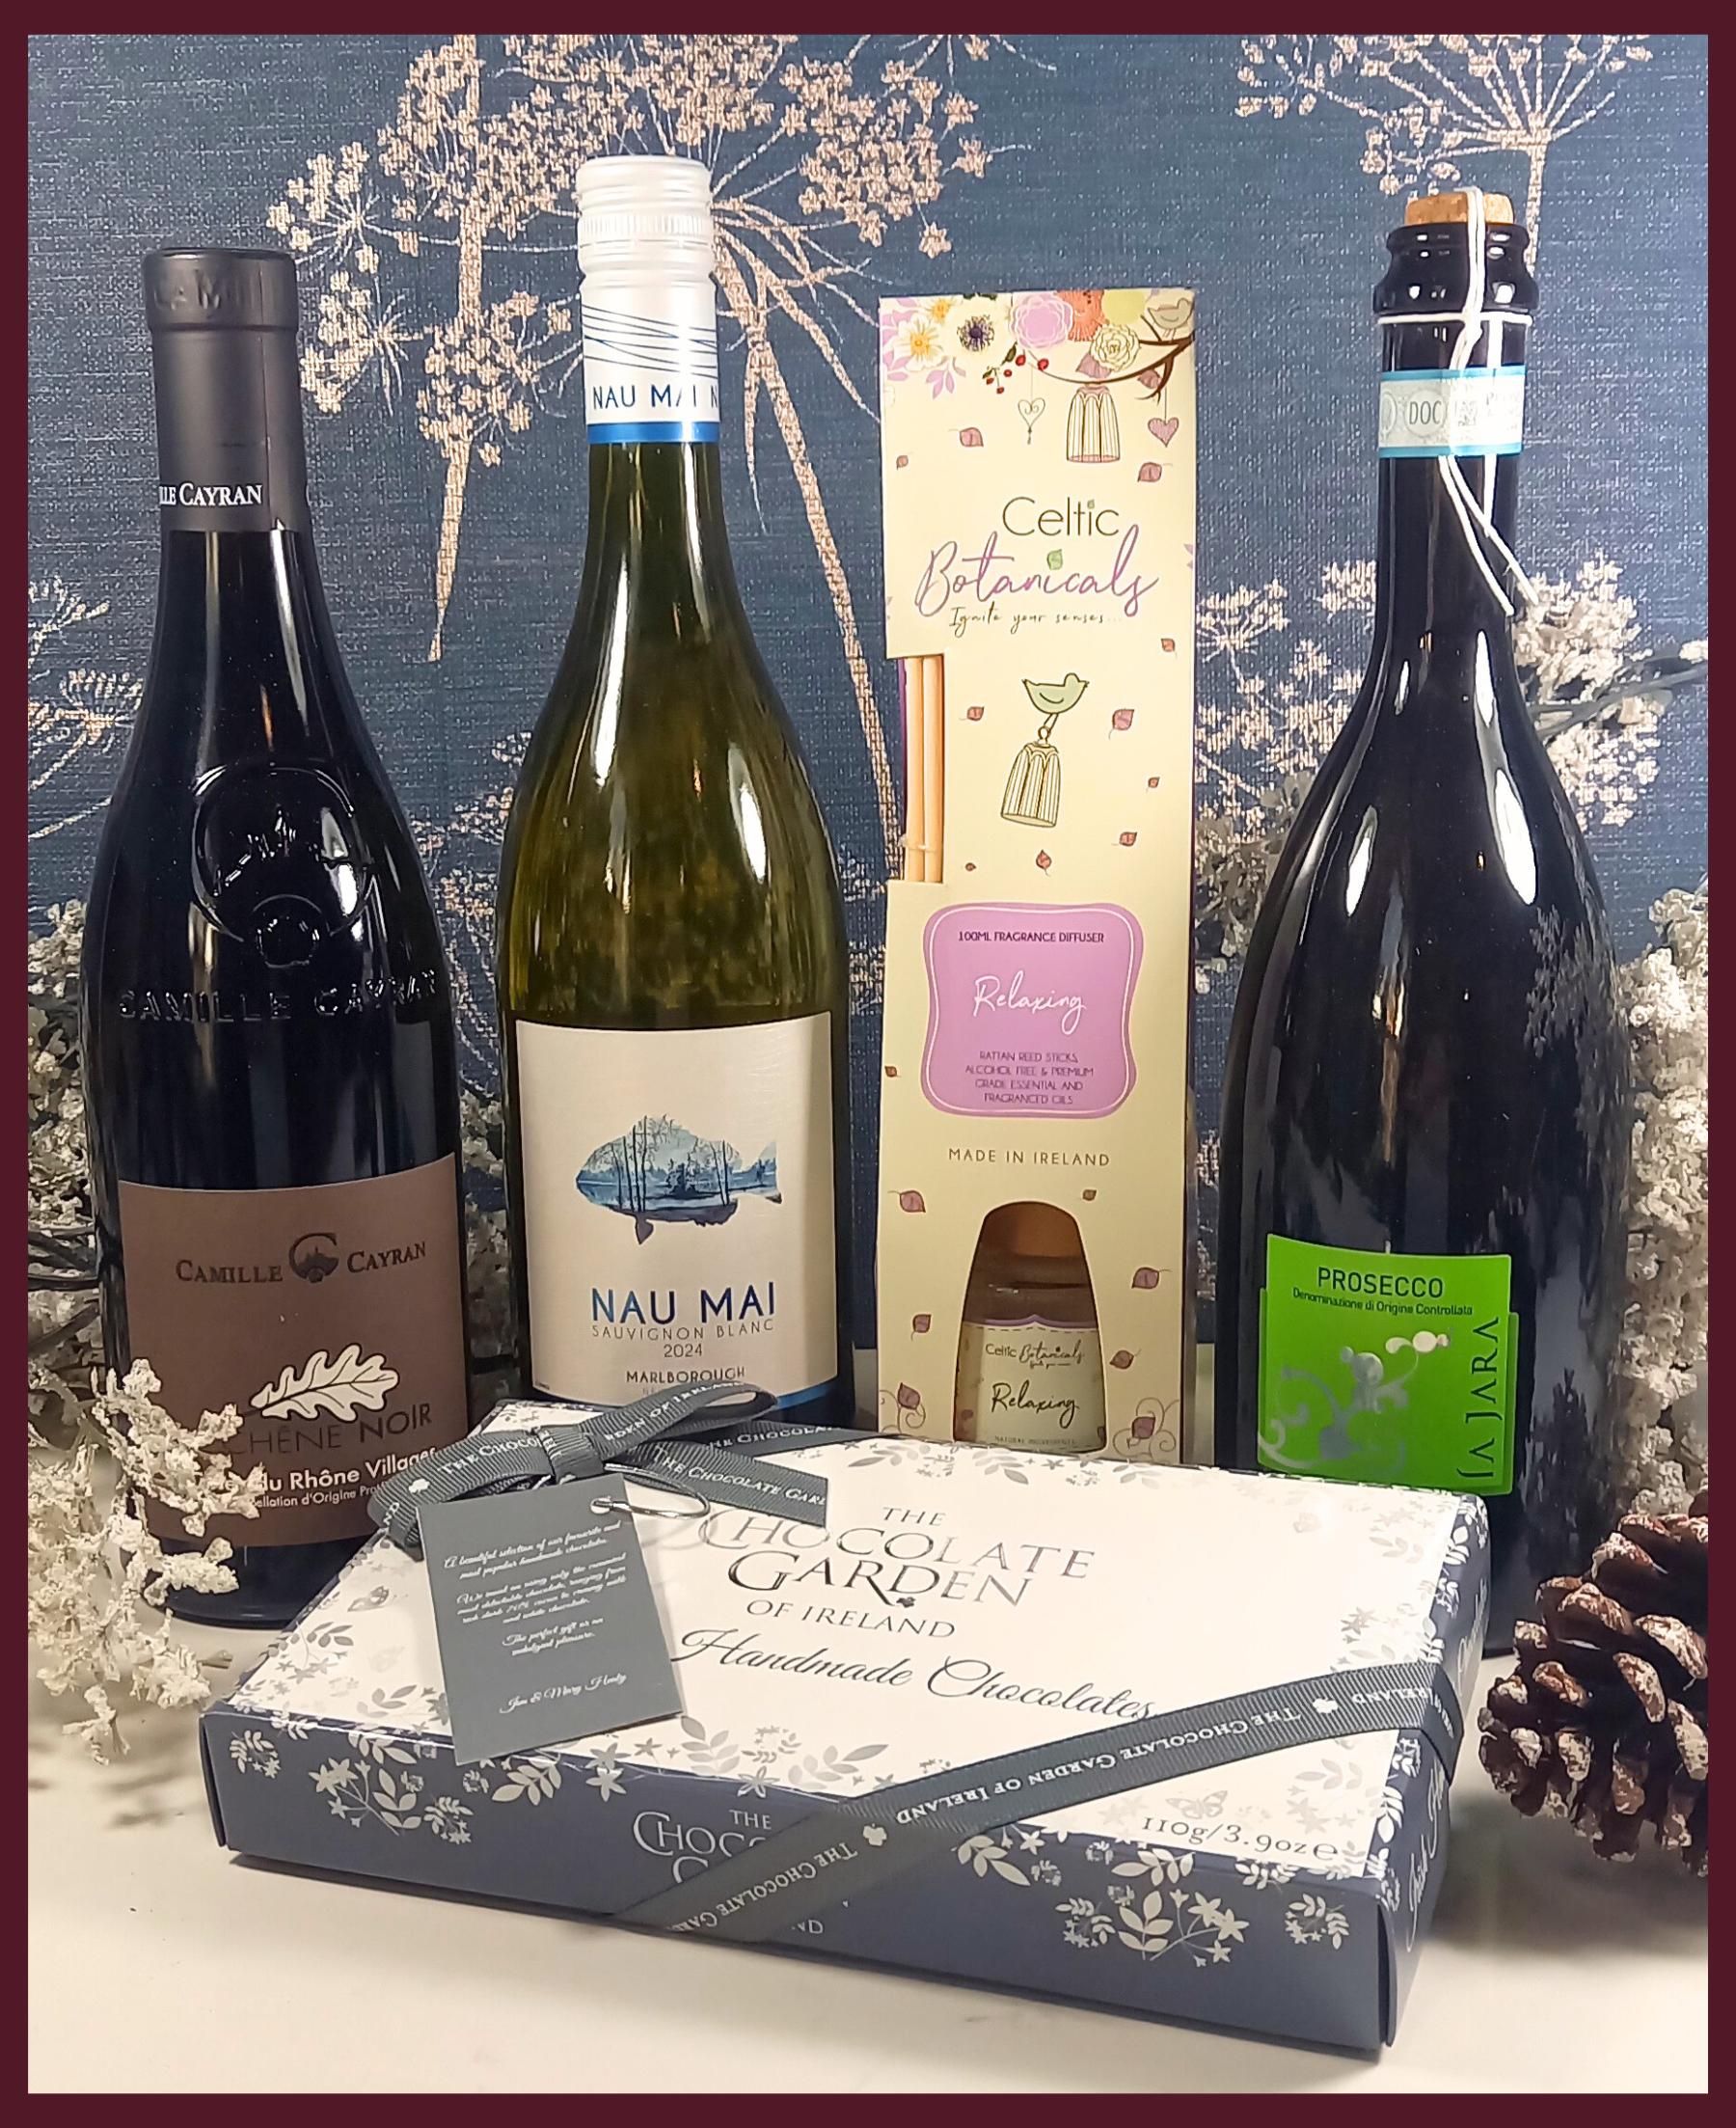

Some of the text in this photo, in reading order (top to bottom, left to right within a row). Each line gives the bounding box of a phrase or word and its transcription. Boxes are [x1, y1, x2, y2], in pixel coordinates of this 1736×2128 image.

[593, 385, 636, 410] NAU
[1409, 400, 1442, 424] DOC
[178, 482, 262, 505] CAYRAN
[1003, 497, 1119, 536] Celtic
[914, 524, 1159, 617] Botanicals
[949, 601, 1002, 638] Ignite
[1010, 613, 1046, 634] your
[959, 931, 1104, 943] 100ML FRAGRANCE DIFFUSER
[973, 969, 1087, 1035] Relaxing
[1051, 1066, 1094, 1077] PREMIUM
[1062, 1081, 1083, 1091] AND
[949, 1148, 1109, 1166] MADE IN IRELAND
[176, 1241, 426, 1284] CAMILLE CAYRAN
[1317, 1266, 1444, 1298] PROSECCO
[591, 1281, 774, 1324] NAU MAI
[1293, 1287, 1473, 1316] Denominazione di Origine Controllata
[592, 1318, 774, 1342] SAUVIGNON BLANC
[663, 1343, 703, 1358] 2024
[626, 1366, 745, 1383] MARLBOROUGH
[990, 1379, 1079, 1429] Relaxing
[360, 1403, 432, 1443] NOIR
[289, 1469, 360, 1490] Rhône
[688, 1466, 782, 1495] CHOCOLATE
[882, 1507, 947, 1528] THE
[697, 1508, 1097, 1579] CHOCOLATE
[727, 1549, 1035, 1607] GARDEN
[746, 1598, 957, 1639] OF IRELAND
[669, 1628, 1156, 1721] Handmade Chocolates
[895, 1706, 1301, 1825] THE CHOCOLATE GARDEN OF IRELAND
[729, 1809, 772, 1830] THE
[817, 1842, 858, 1869] THE
[716, 1862, 817, 1917] CHOCOLATE
